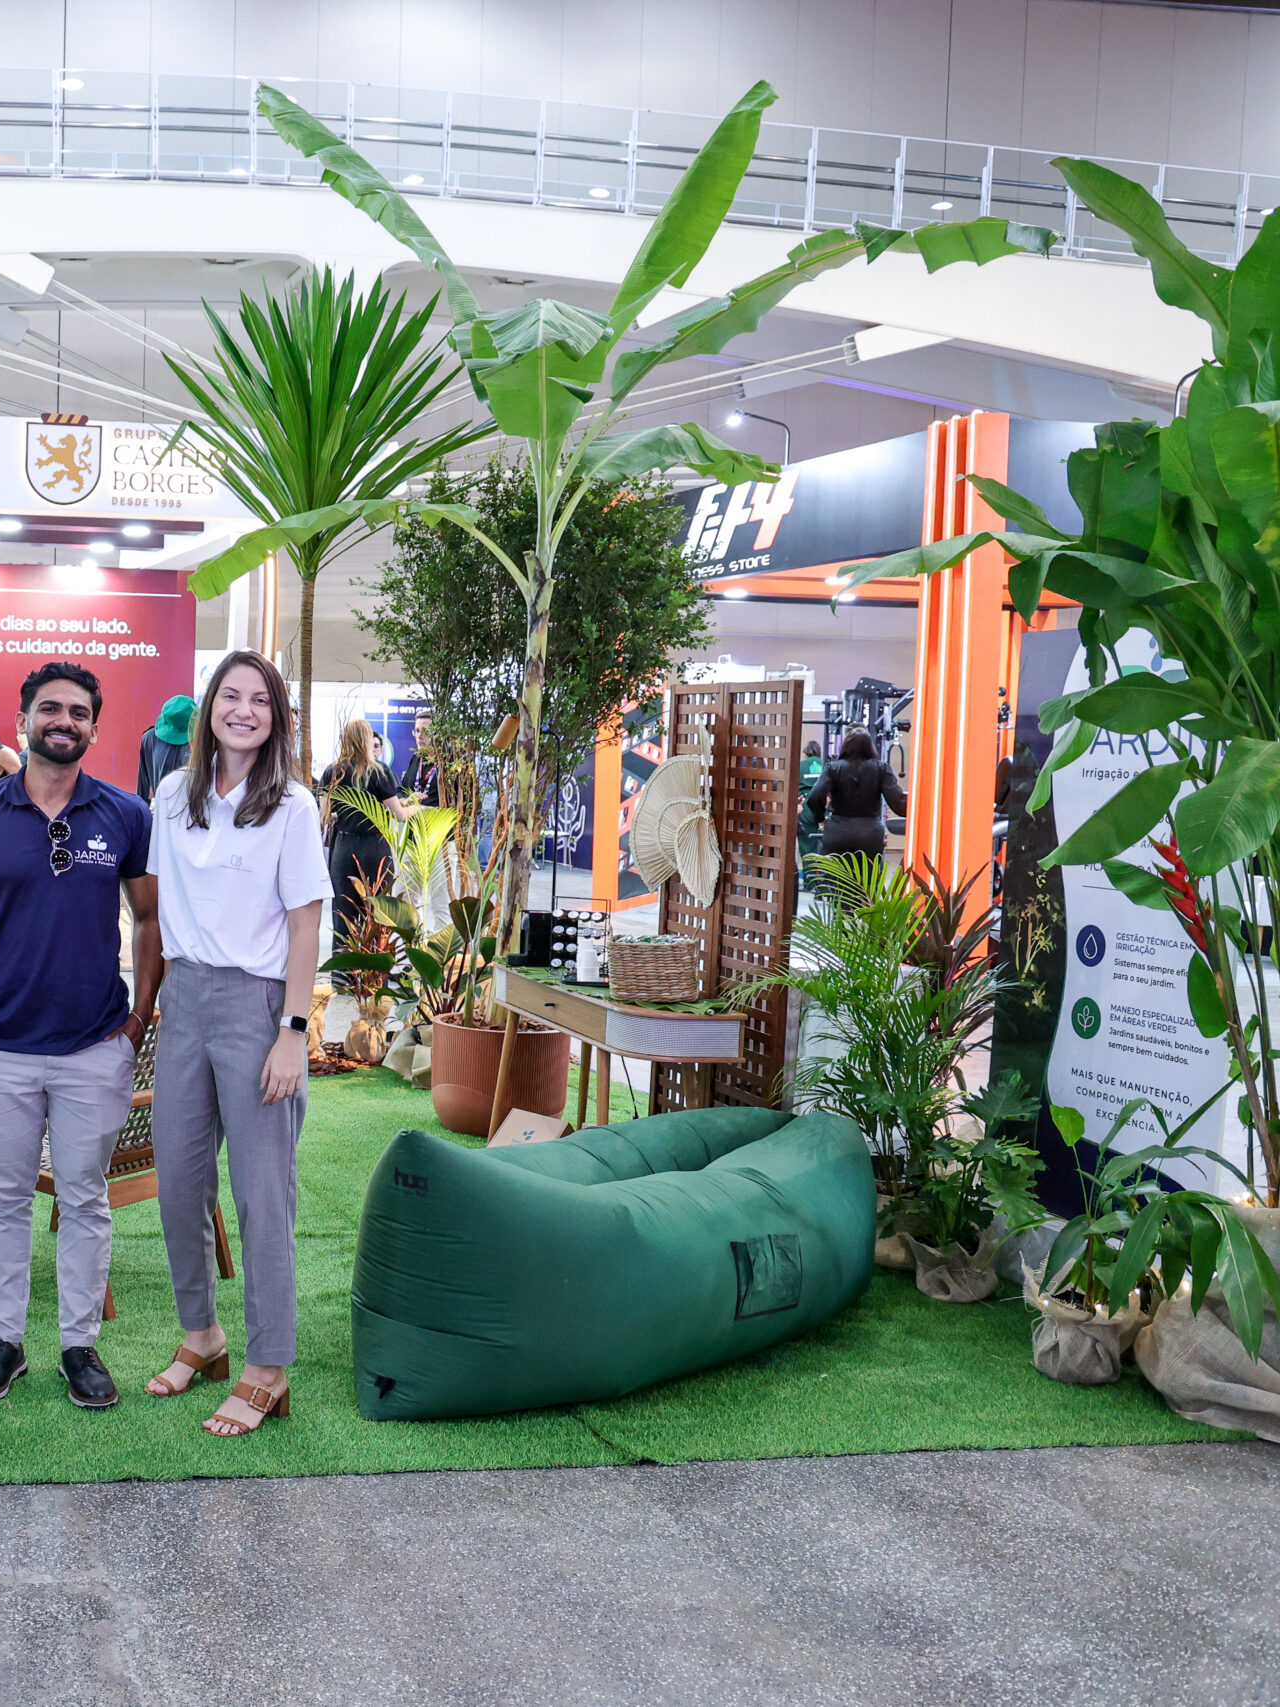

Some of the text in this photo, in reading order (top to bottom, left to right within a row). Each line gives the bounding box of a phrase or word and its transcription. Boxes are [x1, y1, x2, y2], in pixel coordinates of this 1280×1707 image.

[113, 471, 214, 495] BORGES
[112, 496, 182, 508] DESDE 1995
[0, 614, 33, 632] dias
[36, 618, 57, 633] ao
[59, 619, 90, 634] seu
[92, 617, 132, 635] lado.
[5, 638, 82, 655] cuidando
[85, 640, 107, 656] da
[108, 642, 160, 661] gente.
[1081, 767, 1130, 782] Irrigação
[75, 850, 117, 863] JARDINI
[1115, 942, 1156, 956] IRRIGAÇÃO
[1116, 932, 1145, 944] GESTÃO
[1146, 936, 1178, 949] TÉCNICA
[1114, 958, 1146, 970] Sistemas
[1146, 964, 1175, 976] sempre
[1113, 972, 1129, 981] para
[1136, 976, 1149, 985] seu
[1149, 977, 1176, 990] jardim.
[1110, 1003, 1141, 1017] MANEJO
[1109, 1013, 1177, 1034] EM ÁREAS VERDES
[1109, 1026, 1210, 1056] Jardins saudáveis, bonitos e
[1108, 1041, 1190, 1066] sempre bem cuidados.
[1071, 1067, 1193, 1107] MAIS QUE MANUTENÇÃO,
[1176, 1112, 1183, 1122] A
[394, 1166, 429, 1198] hug
